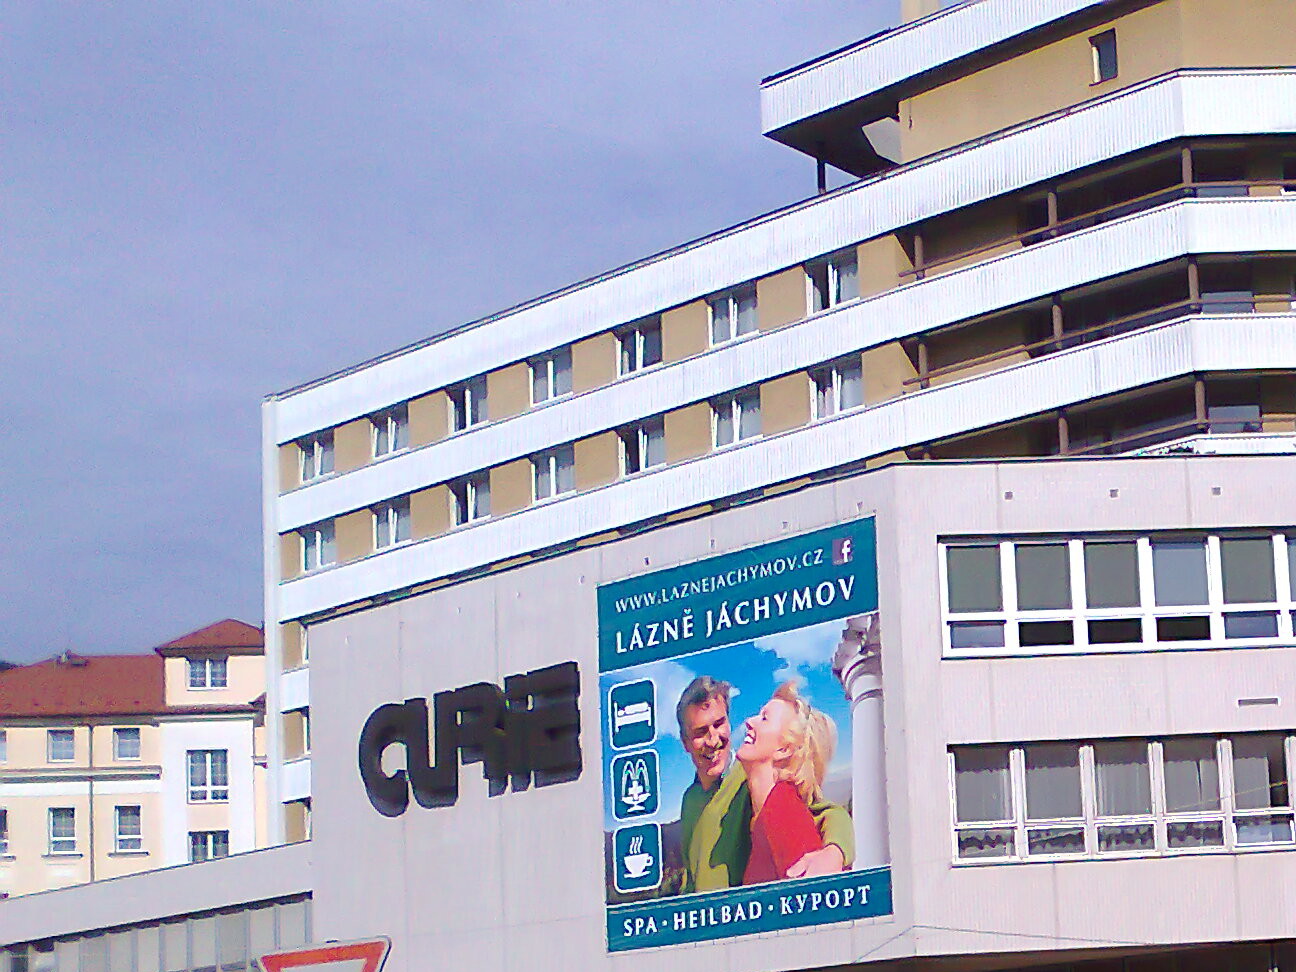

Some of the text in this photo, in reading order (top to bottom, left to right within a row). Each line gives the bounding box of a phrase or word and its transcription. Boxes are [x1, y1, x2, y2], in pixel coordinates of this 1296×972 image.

[841, 539, 852, 564] f
[615, 548, 824, 613] WWW.LAZNEJACHYMOV.CZ
[615, 574, 856, 654] LÁZNĚ JÁCHYMOV
[359, 660, 581, 817] CURIE
[623, 900, 762, 937] SPA HEILBAD
[779, 884, 871, 916] КУРОРТ
